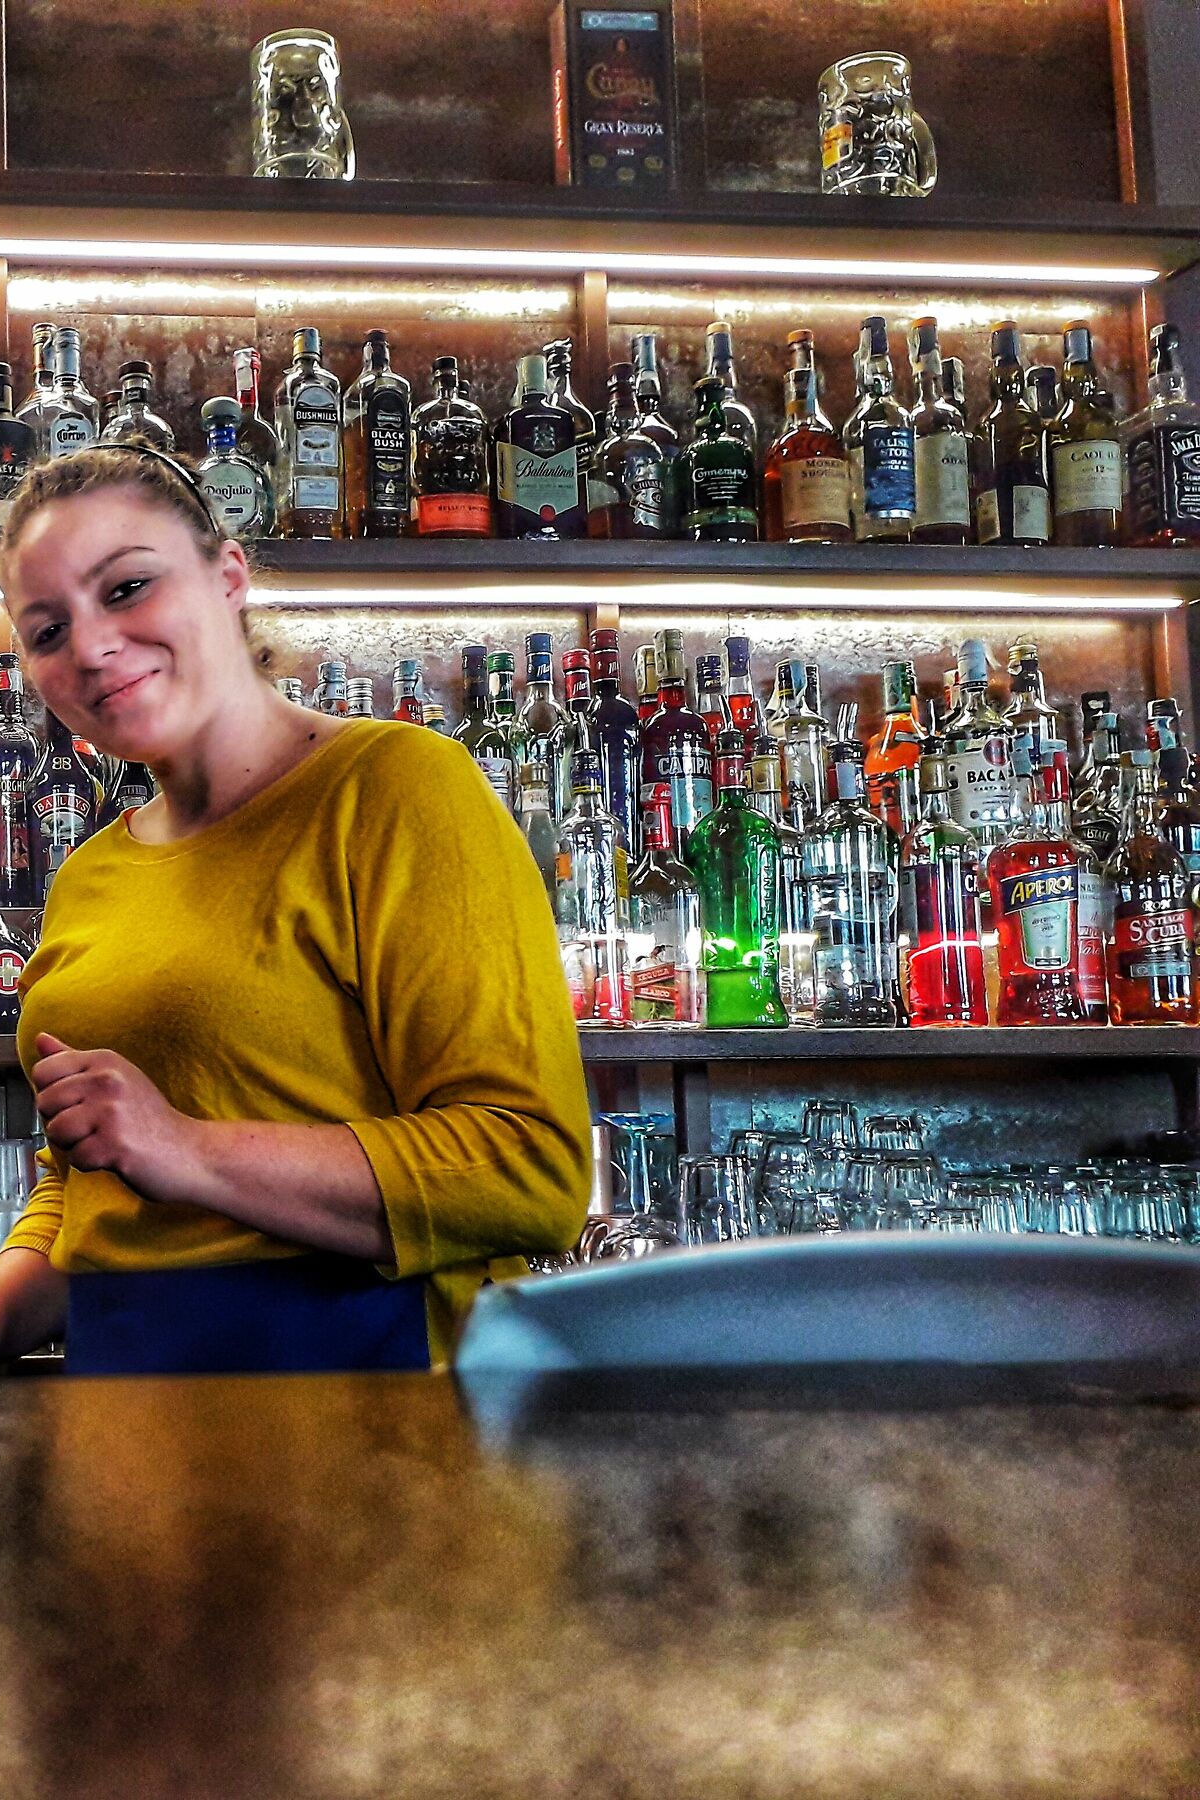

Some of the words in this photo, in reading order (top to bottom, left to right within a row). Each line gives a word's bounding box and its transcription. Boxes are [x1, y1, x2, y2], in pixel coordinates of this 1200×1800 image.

[295, 410, 337, 421] BUSHMILLS
[371, 430, 406, 441] BLACK
[374, 439, 403, 449] BUSH
[1170, 437, 1195, 456] JACK
[1010, 874, 1075, 906] APEROL
[1145, 923, 1186, 945] CUBA
[636, 967, 670, 982] TEQUILA
[640, 986, 670, 998] BLANCO
